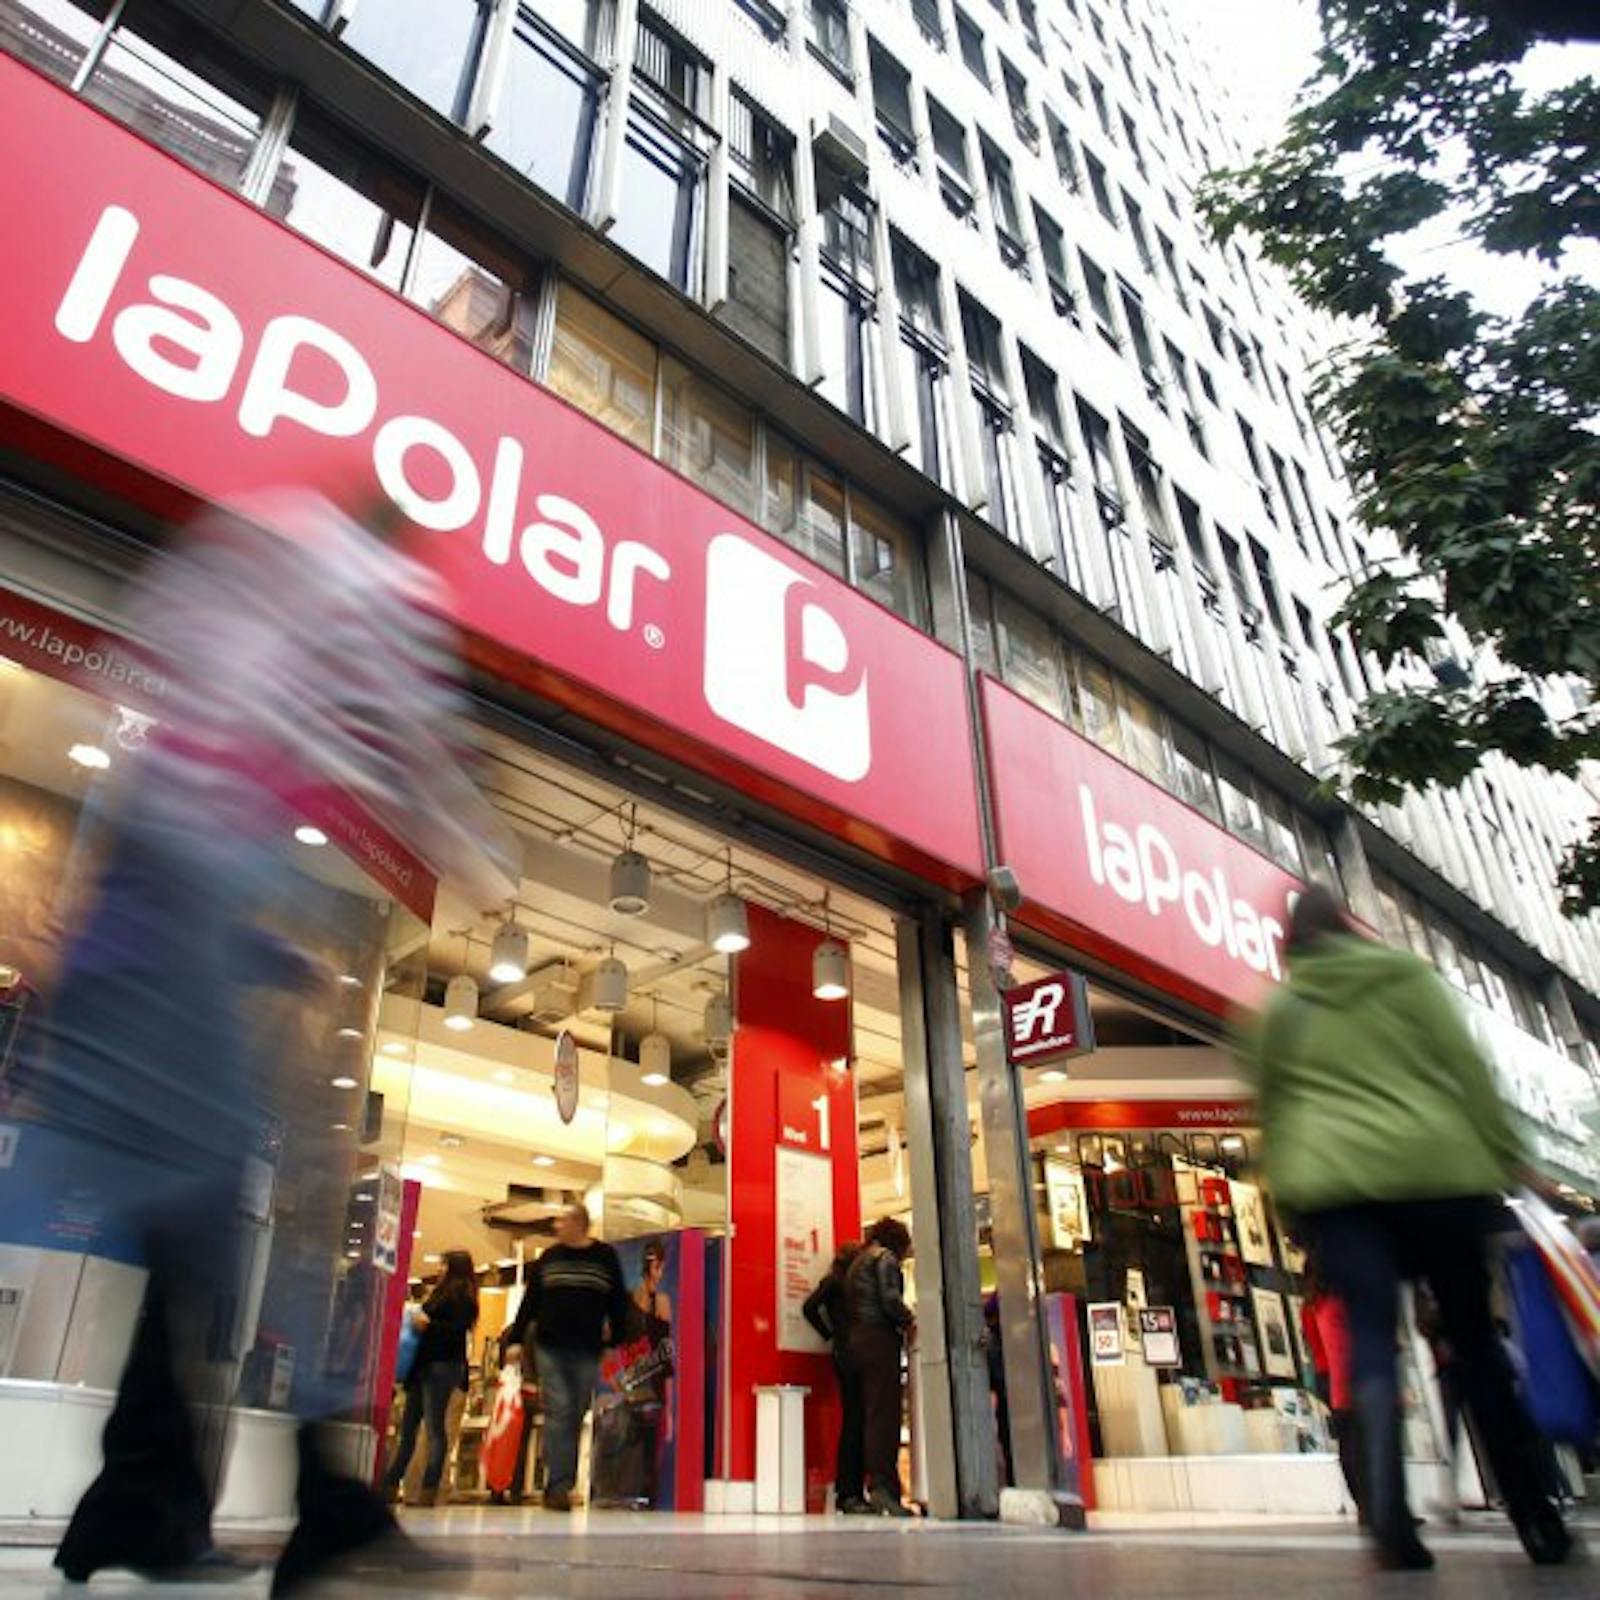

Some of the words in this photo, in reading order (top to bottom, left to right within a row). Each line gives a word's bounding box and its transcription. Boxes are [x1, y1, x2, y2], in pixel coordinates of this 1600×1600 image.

[54, 204, 671, 631] laPolar
[1077, 783, 1285, 982] laPolar
[811, 1094, 831, 1151] 1
